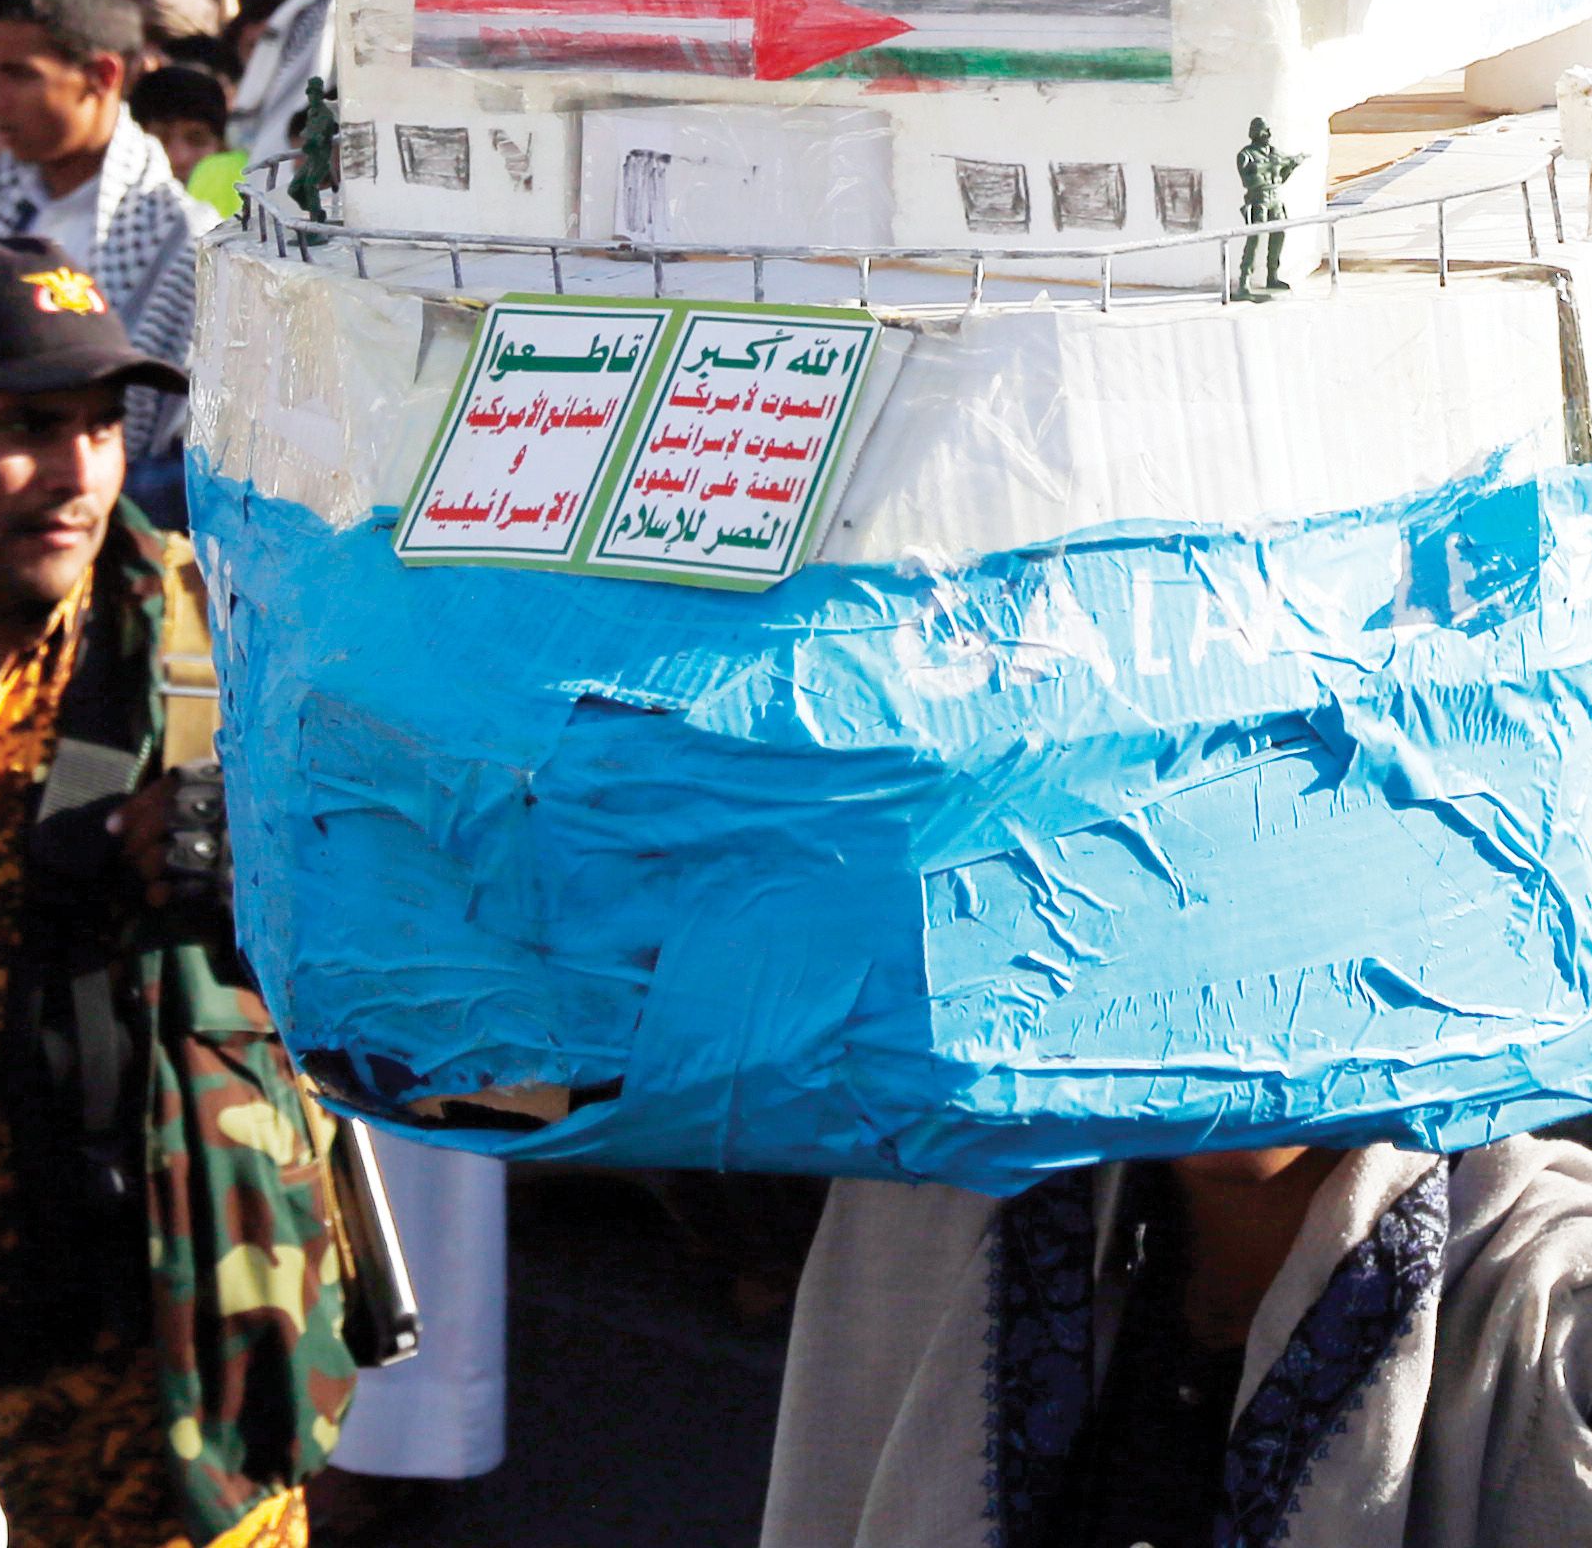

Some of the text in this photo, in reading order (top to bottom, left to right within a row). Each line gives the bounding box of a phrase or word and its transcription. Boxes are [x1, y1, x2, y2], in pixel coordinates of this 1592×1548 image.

[487, 330, 644, 382] قاطعوا
[682, 328, 856, 380] الله أكبر
[465, 389, 619, 437] البضائع الأمريكية
[669, 380, 837, 421] الموت لأمريكا
[508, 444, 528, 475] و
[649, 423, 822, 462] الموت لإسرائيل
[634, 467, 806, 505] اللعنة على اليهود
[424, 487, 579, 533] الإسرائيلية
[611, 503, 791, 555] النصر للإسلام
